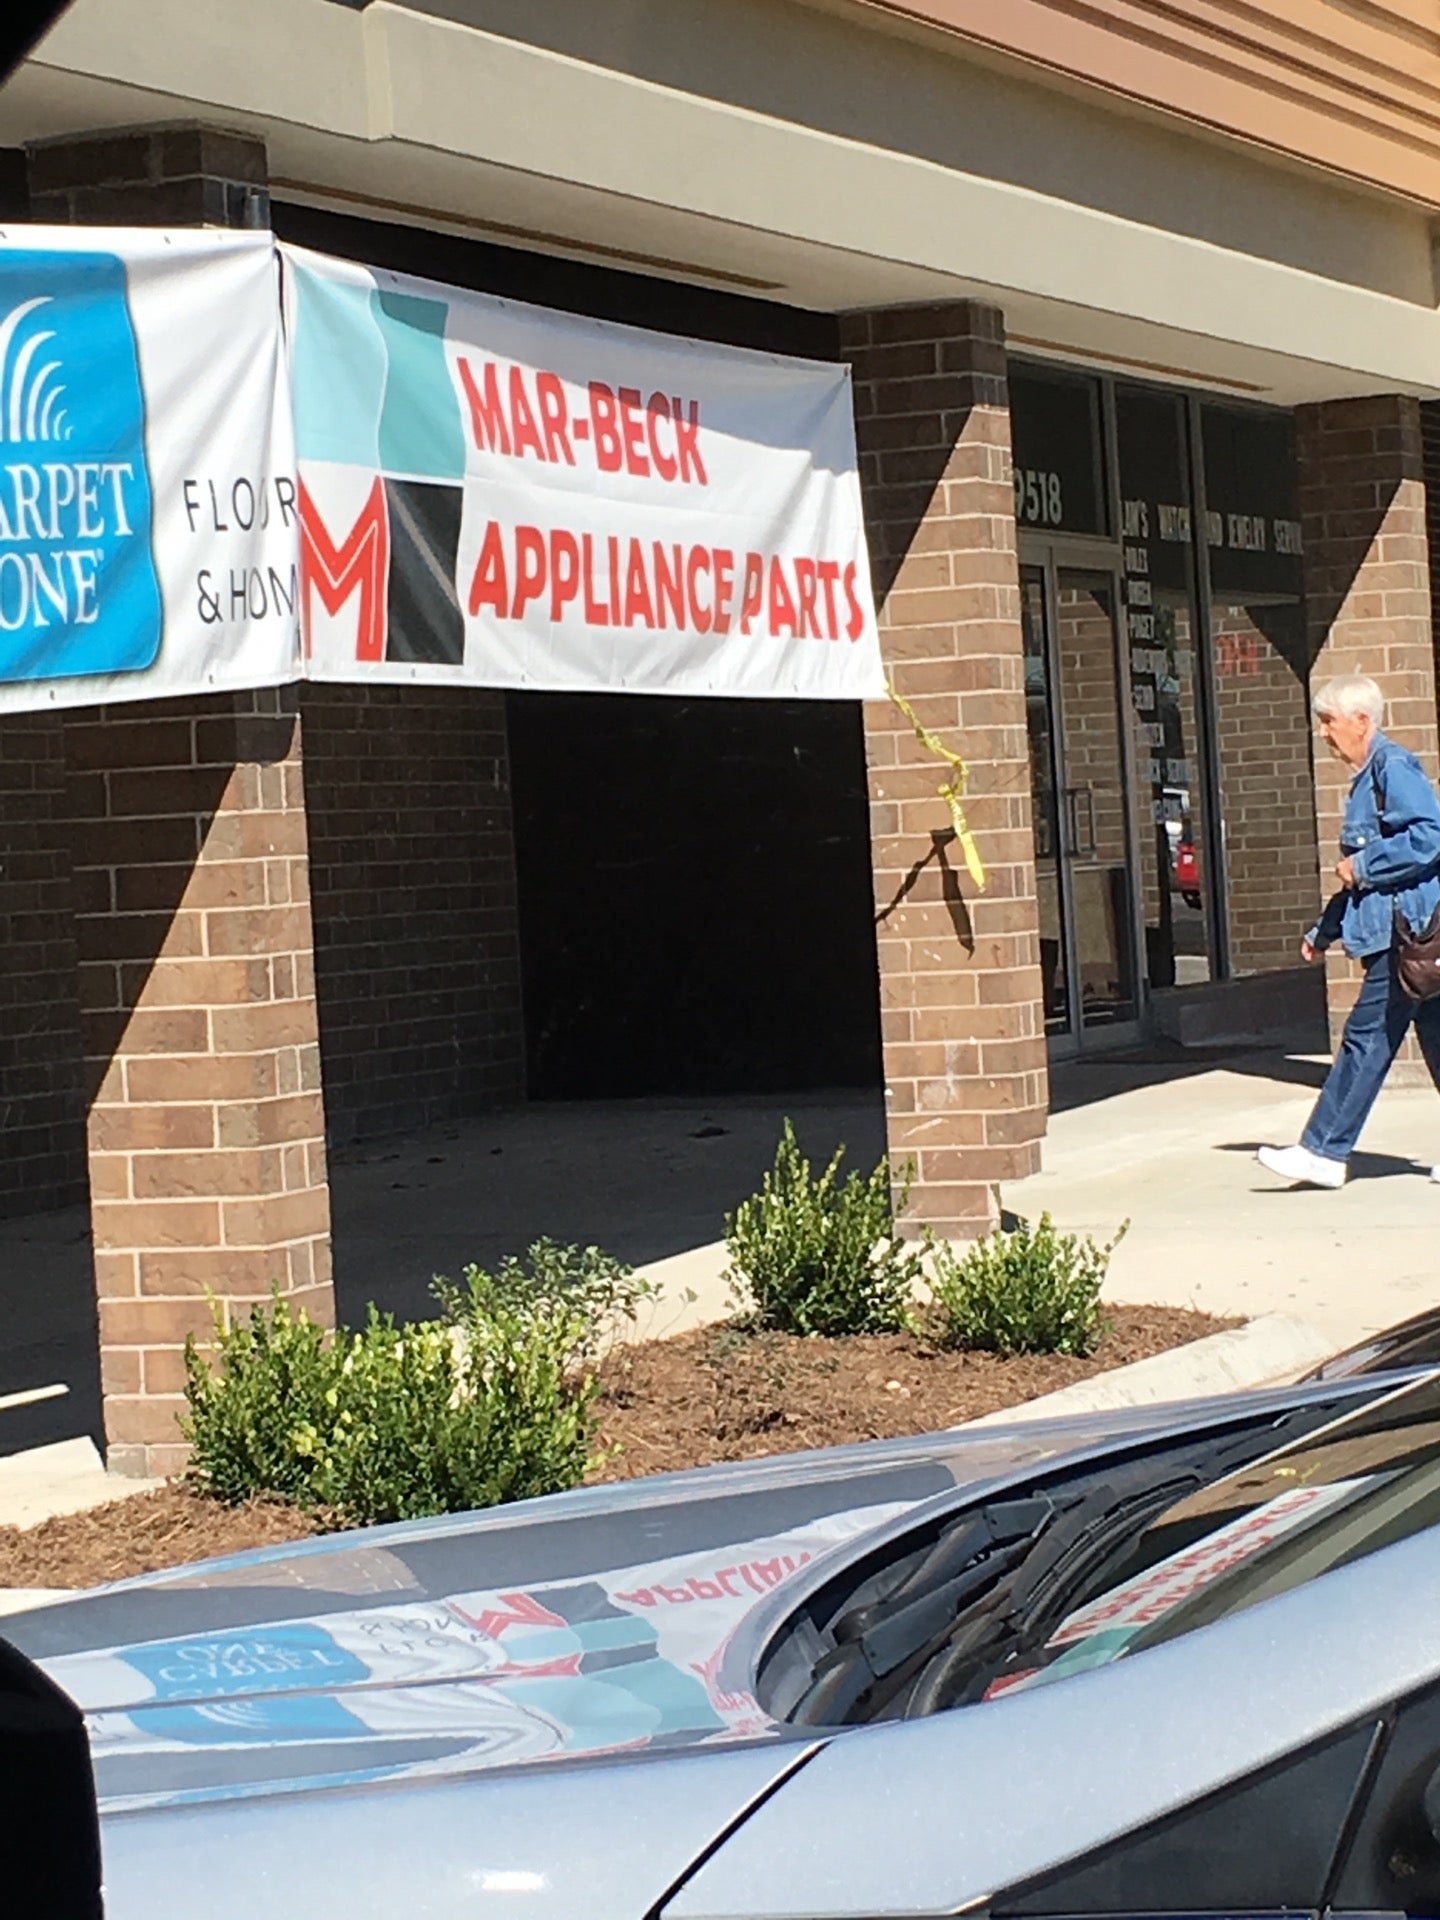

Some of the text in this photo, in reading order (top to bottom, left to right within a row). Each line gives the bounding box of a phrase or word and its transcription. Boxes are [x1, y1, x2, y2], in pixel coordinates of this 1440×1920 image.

[457, 357, 708, 486] MAR-BECK
[0, 549, 99, 631] ONE
[197, 569, 223, 624] &
[468, 521, 865, 643] APPLIANCE PARTS
